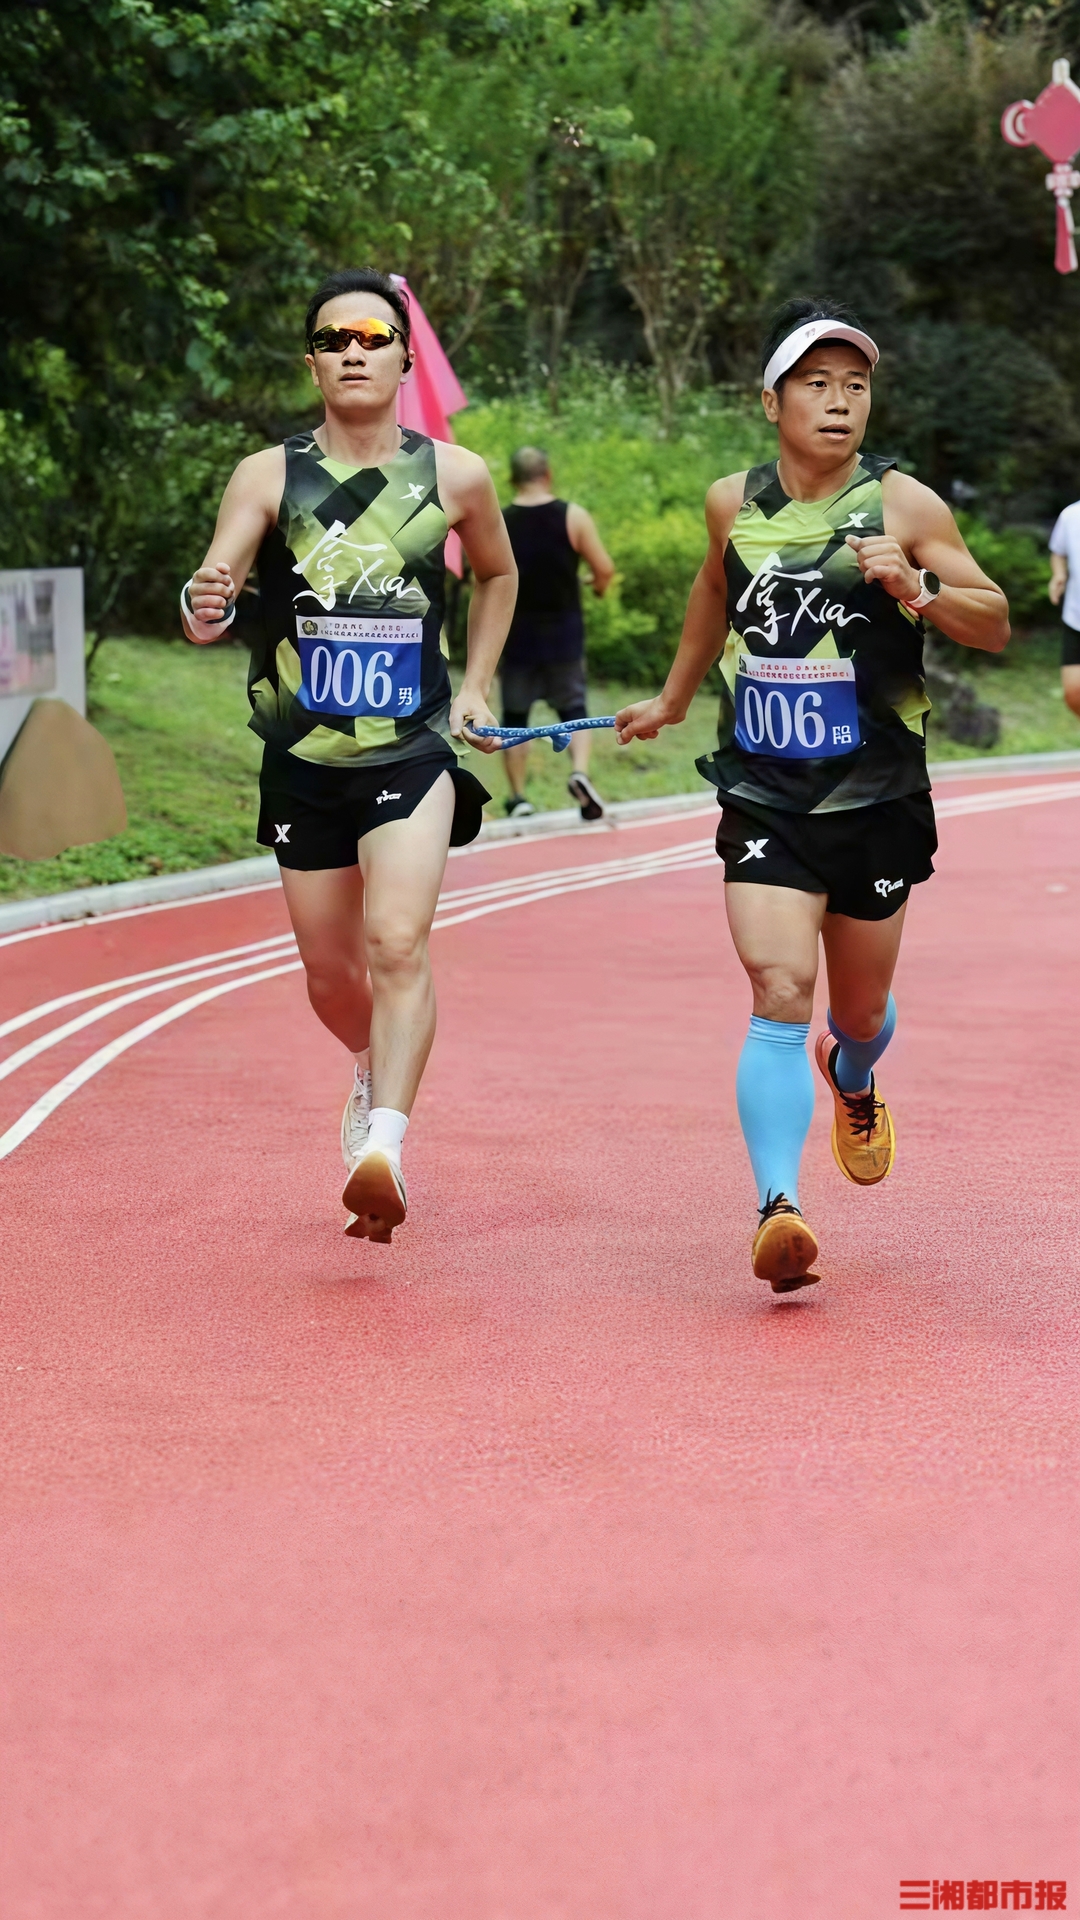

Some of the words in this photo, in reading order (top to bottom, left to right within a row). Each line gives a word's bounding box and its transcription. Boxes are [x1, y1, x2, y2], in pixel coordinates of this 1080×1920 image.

[310, 645, 394, 708] 006
[397, 686, 413, 706] 男
[743, 685, 826, 750] 006
